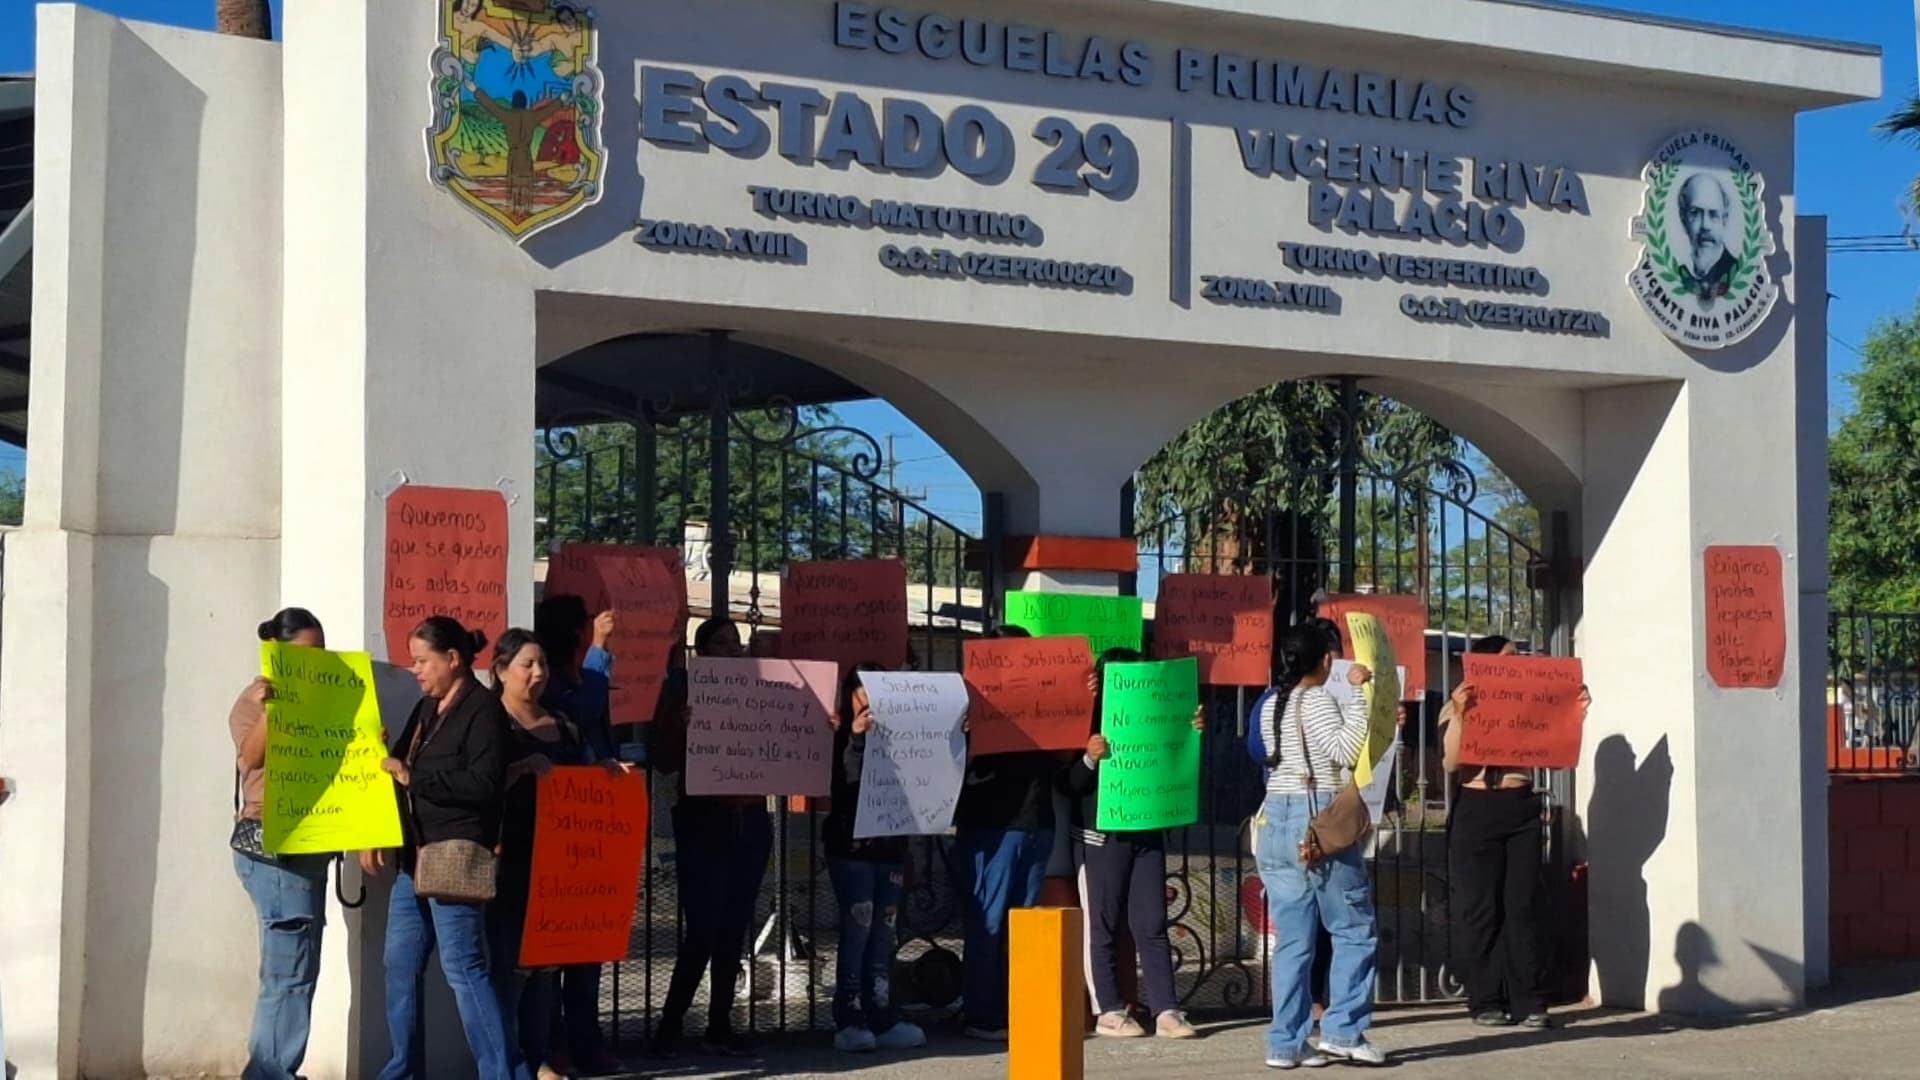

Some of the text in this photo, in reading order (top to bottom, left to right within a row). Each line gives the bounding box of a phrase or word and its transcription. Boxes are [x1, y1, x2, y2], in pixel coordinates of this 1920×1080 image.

[834, 2, 1475, 128] ESCUELAS PRIMARIAS
[641, 66, 1138, 198] ESTADO 29
[1234, 126, 1589, 214] VICENTE RIVA
[1649, 133, 1758, 192] ESCUELA PRIMARIA
[748, 185, 1038, 242] TURNO MATUTINO
[1308, 180, 1519, 251] PALACIO
[634, 220, 801, 261] ZONA XVIII
[1278, 242, 1544, 293] TURNO VESPERTINO
[1201, 275, 1337, 312] ZONA XVIII
[1690, 314, 1720, 330] RIVA
[401, 503, 486, 532] Queremos
[390, 539, 418, 563] que
[425, 541, 446, 558] se
[390, 569, 416, 591] las
[426, 568, 470, 594] aulas
[1709, 553, 1769, 584] Exigimos
[1714, 583, 1754, 609] pronta
[1024, 596, 1128, 624] NO AL
[1717, 604, 1774, 630] respuesta
[271, 649, 367, 688] No al cierre de
[970, 647, 1089, 670] Aulas saturadas
[1719, 648, 1773, 667] Padres de
[694, 668, 720, 686] Cada
[882, 676, 940, 694] Sistema
[1114, 673, 1168, 692] Queremos
[803, 702, 810, 718] y
[876, 698, 938, 716] Educativo
[1113, 707, 1131, 728] No
[273, 712, 319, 738] Nuestros
[780, 718, 815, 741] digna
[872, 721, 952, 746] Necesitamo
[321, 746, 379, 766] mejores
[726, 740, 754, 758] aulas
[760, 740, 782, 760] NO
[807, 747, 821, 761] la
[339, 765, 378, 791] mejor
[916, 774, 931, 787] su
[1110, 778, 1152, 800] Mejores
[1109, 805, 1153, 826] Mejores
